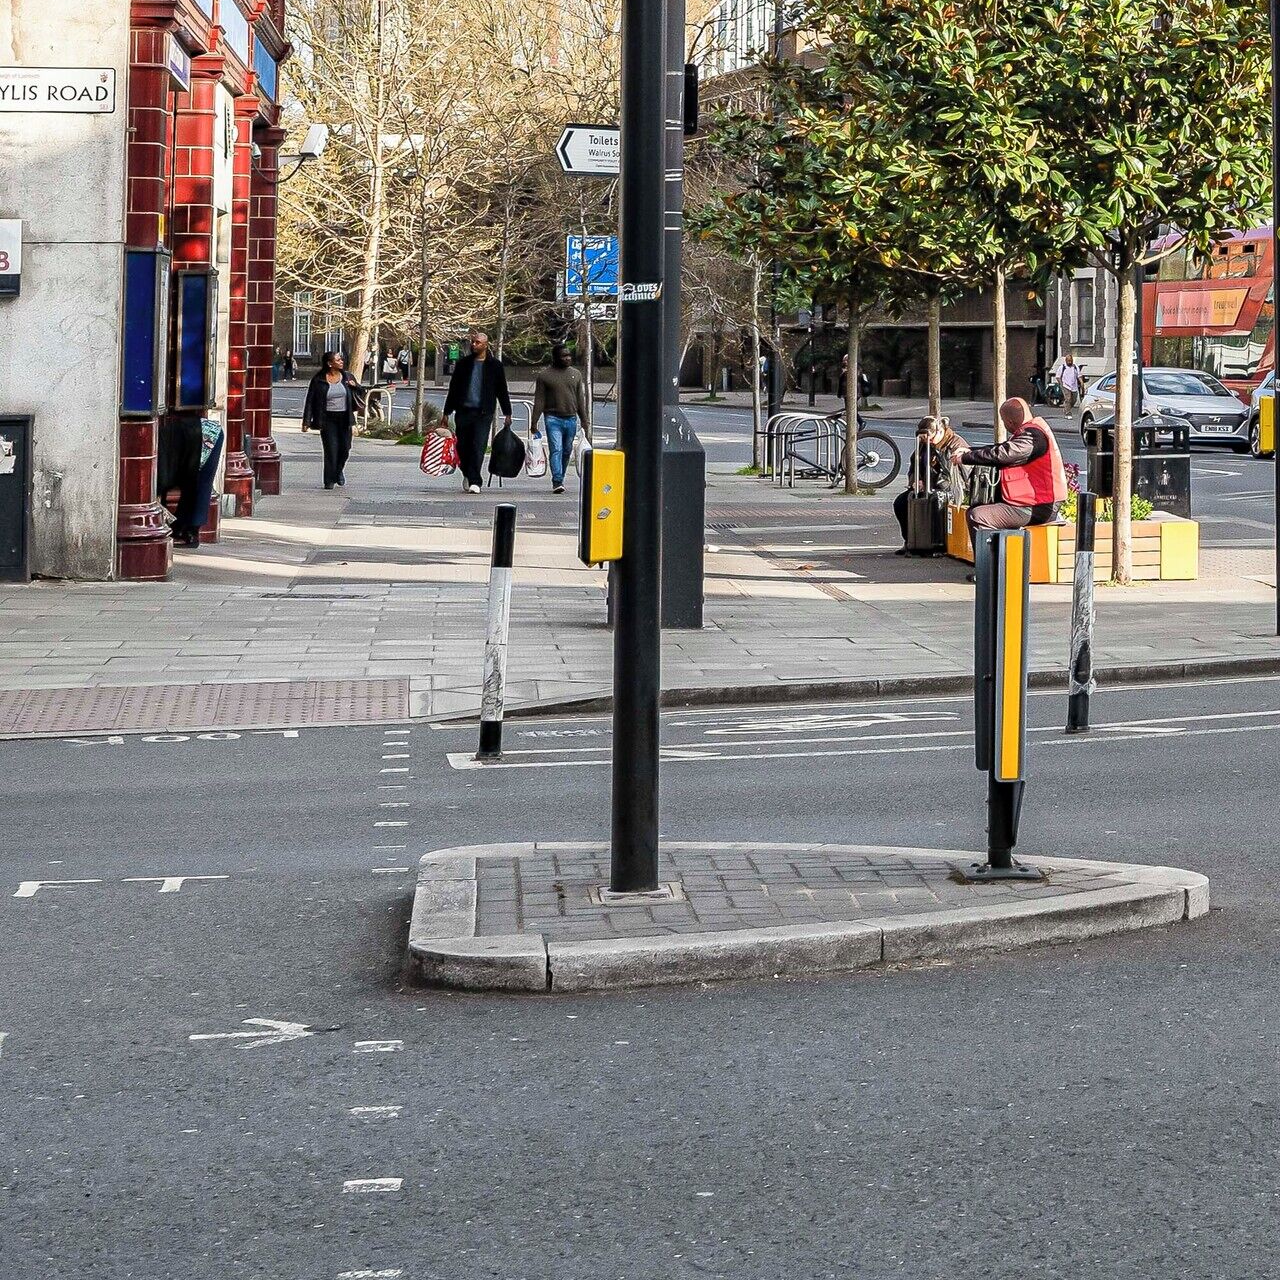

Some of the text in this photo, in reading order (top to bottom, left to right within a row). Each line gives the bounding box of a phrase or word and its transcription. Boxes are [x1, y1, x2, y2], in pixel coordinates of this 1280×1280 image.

[47, 85, 109, 102] ROAD
[588, 135, 619, 146] Toilets
[588, 149, 611, 158] Walrus
